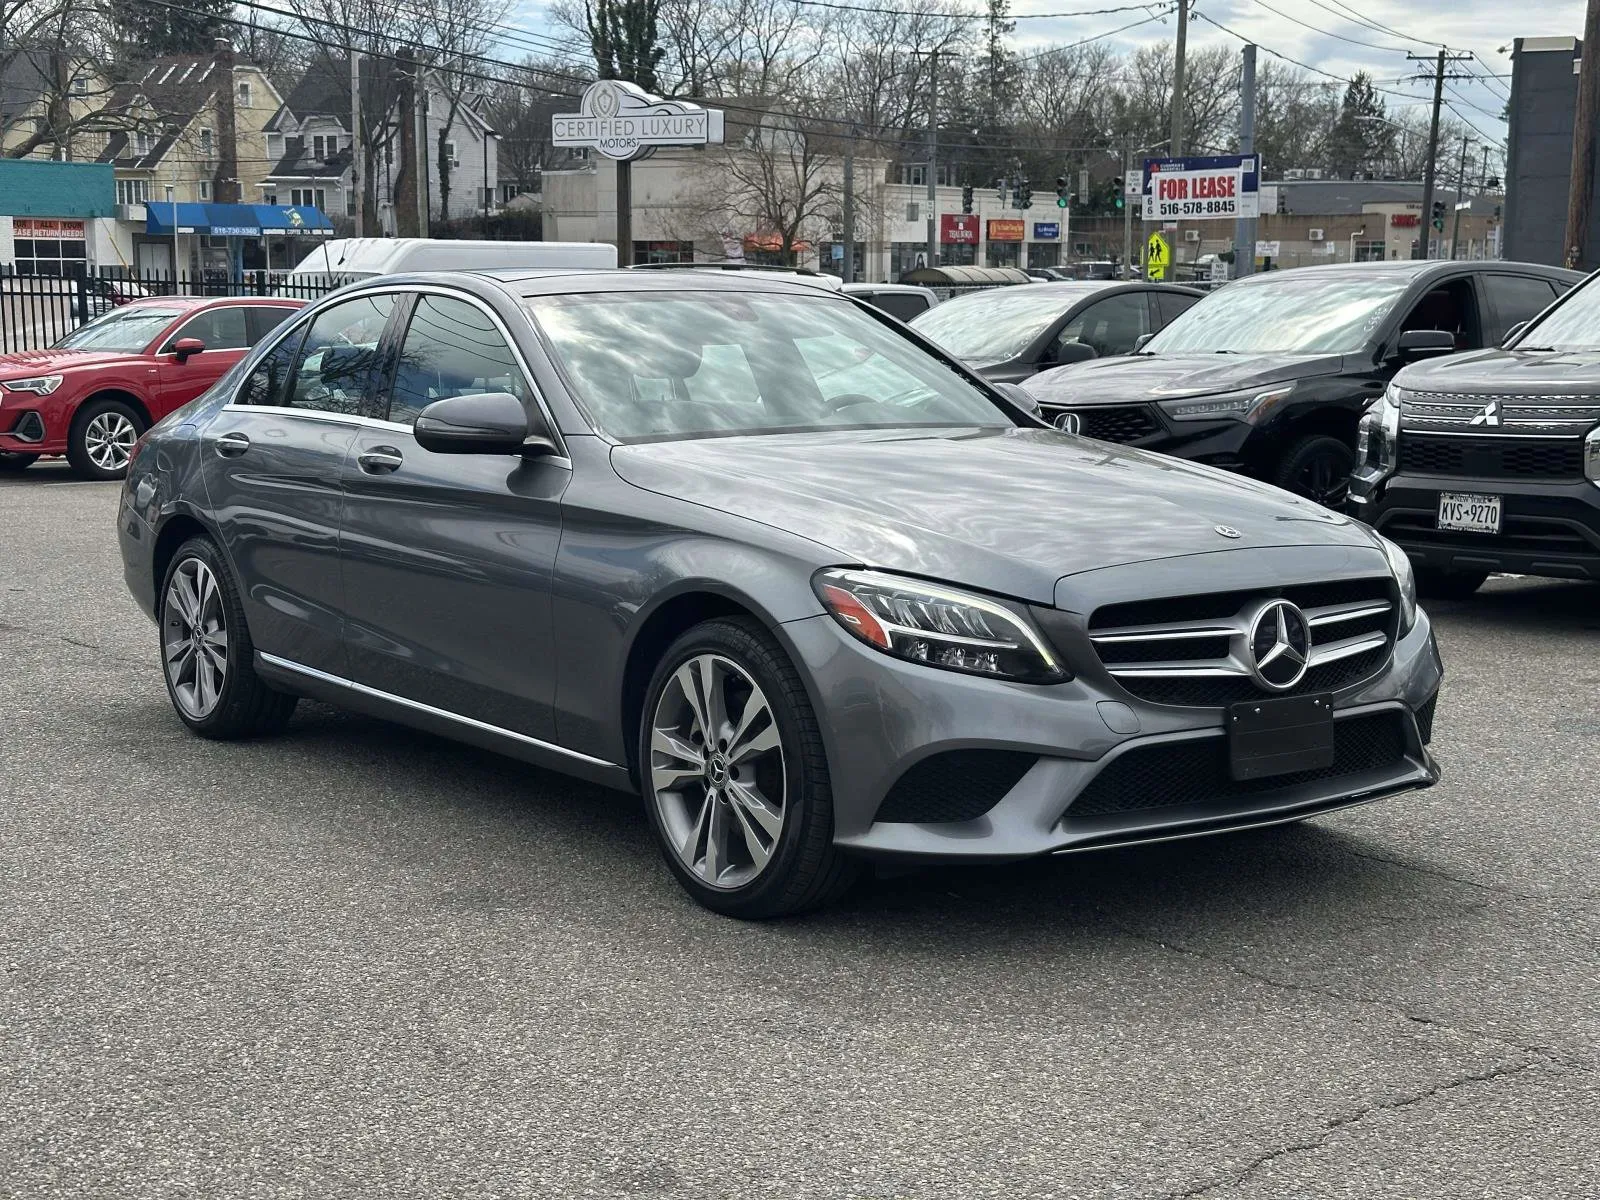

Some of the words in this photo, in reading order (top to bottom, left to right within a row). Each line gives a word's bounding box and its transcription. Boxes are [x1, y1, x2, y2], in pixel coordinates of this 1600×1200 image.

[554, 120, 635, 137] CERTIFIED
[642, 118, 705, 136] LUXURY
[600, 138, 636, 149] MOTORS
[1159, 178, 1188, 200] FOR
[1191, 176, 1236, 199] LEASE
[1160, 200, 1235, 216] 516-578-8845
[34, 229, 60, 237] RETURN
